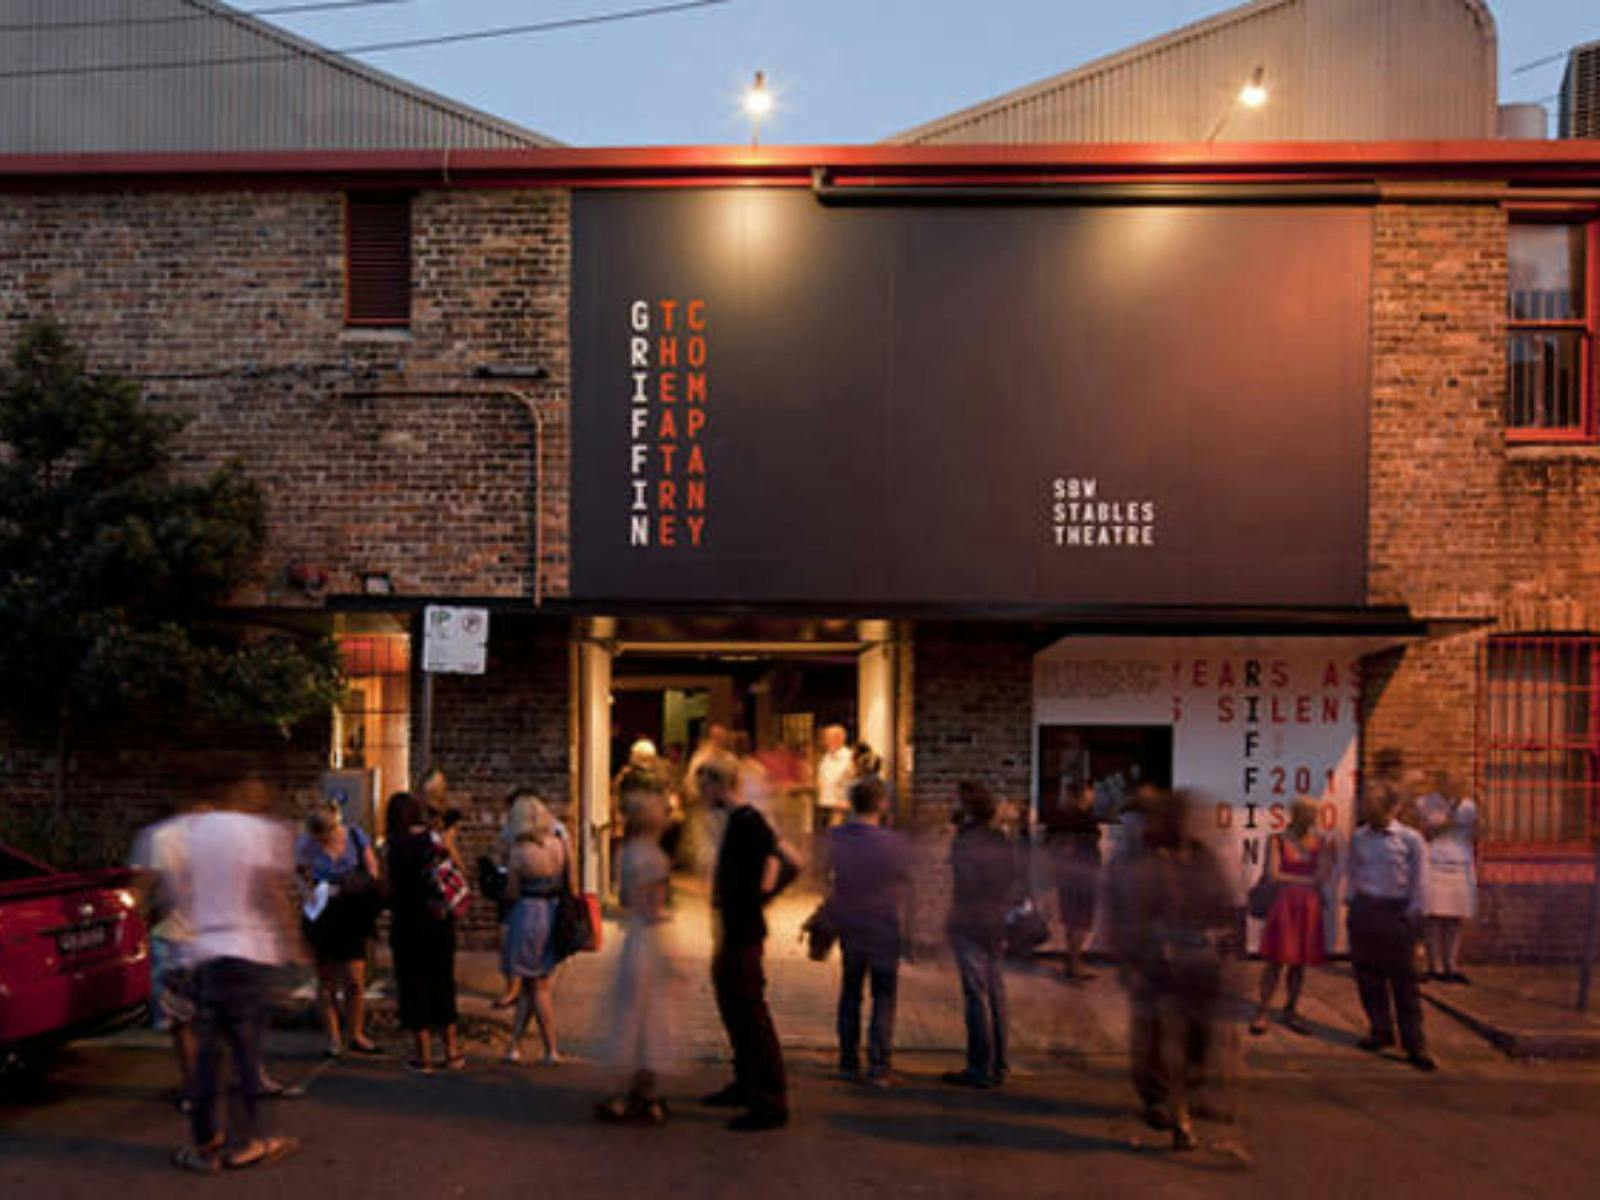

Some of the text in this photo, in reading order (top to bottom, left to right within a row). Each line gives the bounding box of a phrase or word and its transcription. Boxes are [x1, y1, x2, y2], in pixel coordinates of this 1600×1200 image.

[631, 300, 649, 546] GRIFFIN
[657, 300, 678, 546] THEATRE
[686, 300, 707, 546] COMPANY
[1053, 501, 1155, 522] STABLES
[1053, 525, 1155, 545] THEATRE
